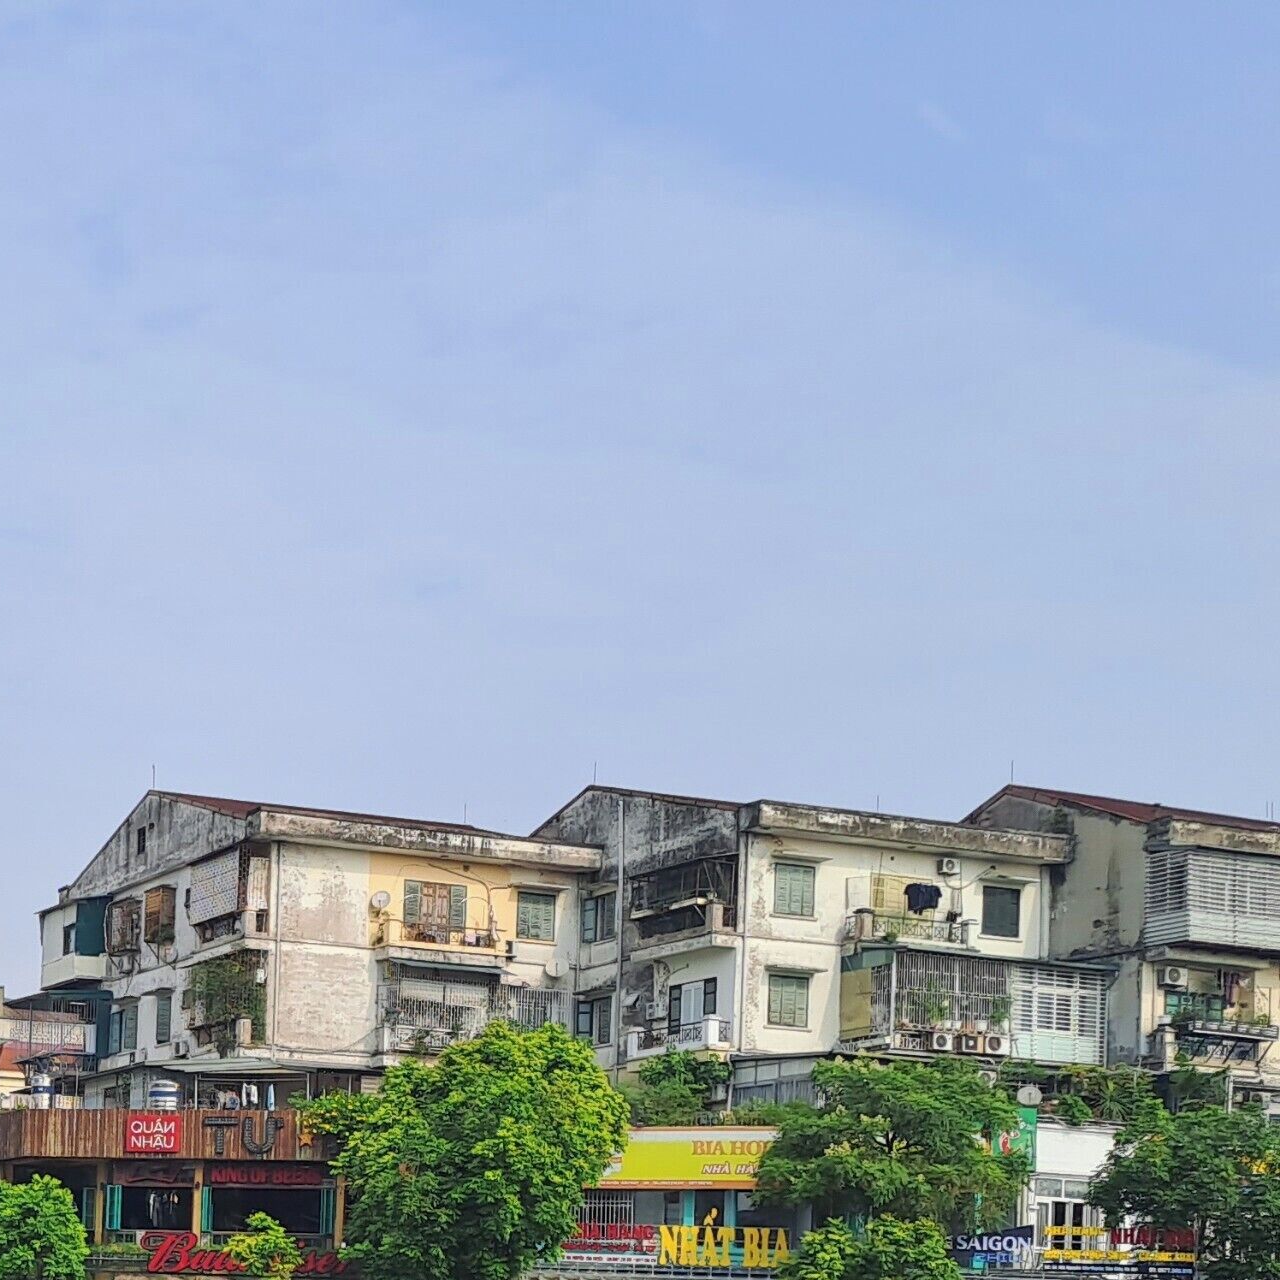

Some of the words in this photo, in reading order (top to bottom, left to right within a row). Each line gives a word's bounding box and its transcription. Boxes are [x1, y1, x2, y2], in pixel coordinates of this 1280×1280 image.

[131, 1117, 175, 1134] QUÁN
[131, 1133, 175, 1150] NHẬU
[691, 1140, 725, 1156] BIA
[211, 1167, 248, 1184] KING
[251, 1168, 267, 1184] OF
[702, 1161, 731, 1175] NHÀ
[658, 1207, 736, 1268] NHẤT
[742, 1227, 791, 1268] BIA
[956, 1235, 1032, 1252] SAIGON
